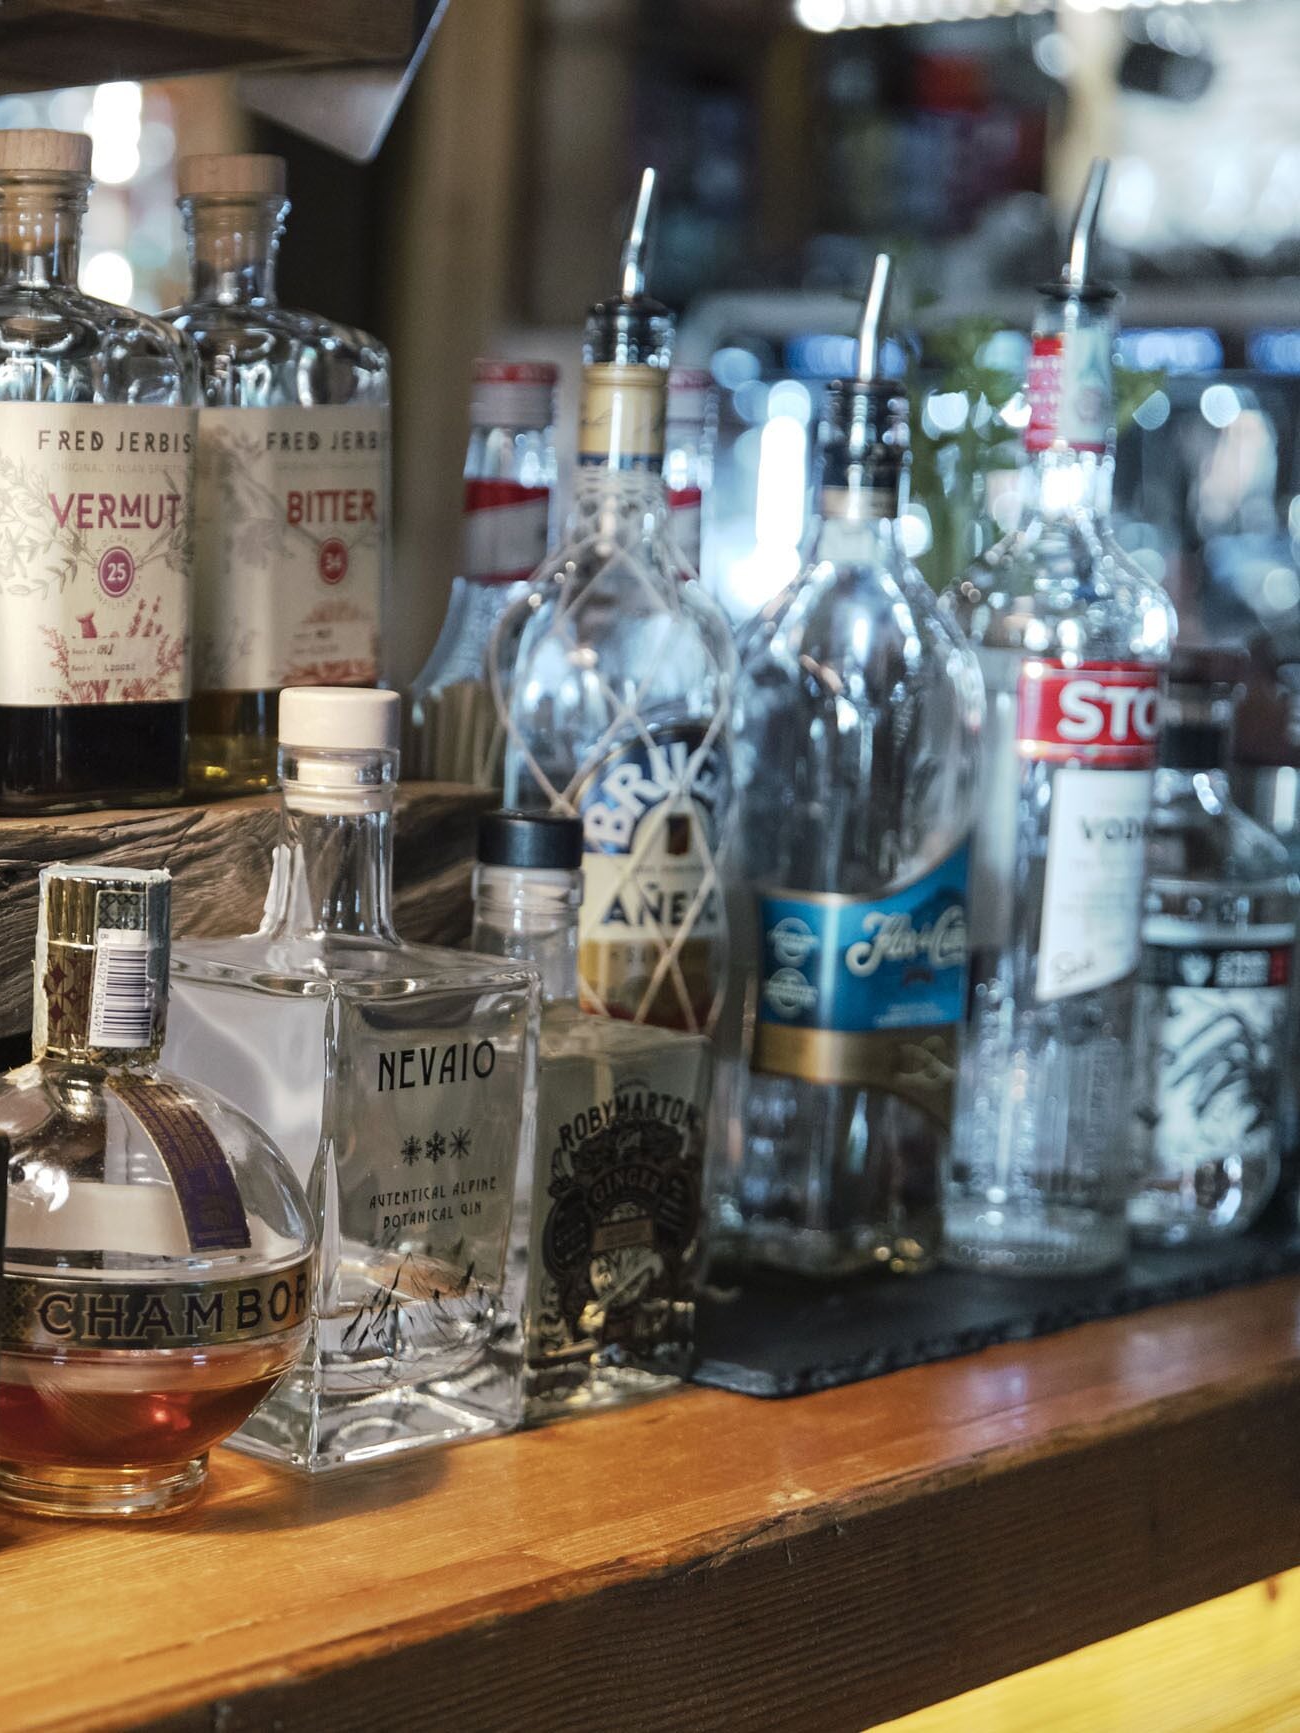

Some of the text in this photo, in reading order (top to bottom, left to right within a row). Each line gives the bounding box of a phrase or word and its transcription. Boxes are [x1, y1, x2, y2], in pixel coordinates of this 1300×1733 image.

[38, 430, 192, 453] FRED JERBIS
[266, 430, 378, 451] FRED JERB
[48, 493, 182, 529] VERMUT
[287, 488, 378, 525] BITTER
[107, 562, 127, 582] 25
[1056, 679, 1160, 742] STO
[378, 1039, 496, 1092] NEVAIO
[369, 1176, 498, 1209] AUTENTICAL ALPINE
[383, 1201, 483, 1229] BOTANICAL GIN
[36, 1273, 312, 1340] CHAMBOR
